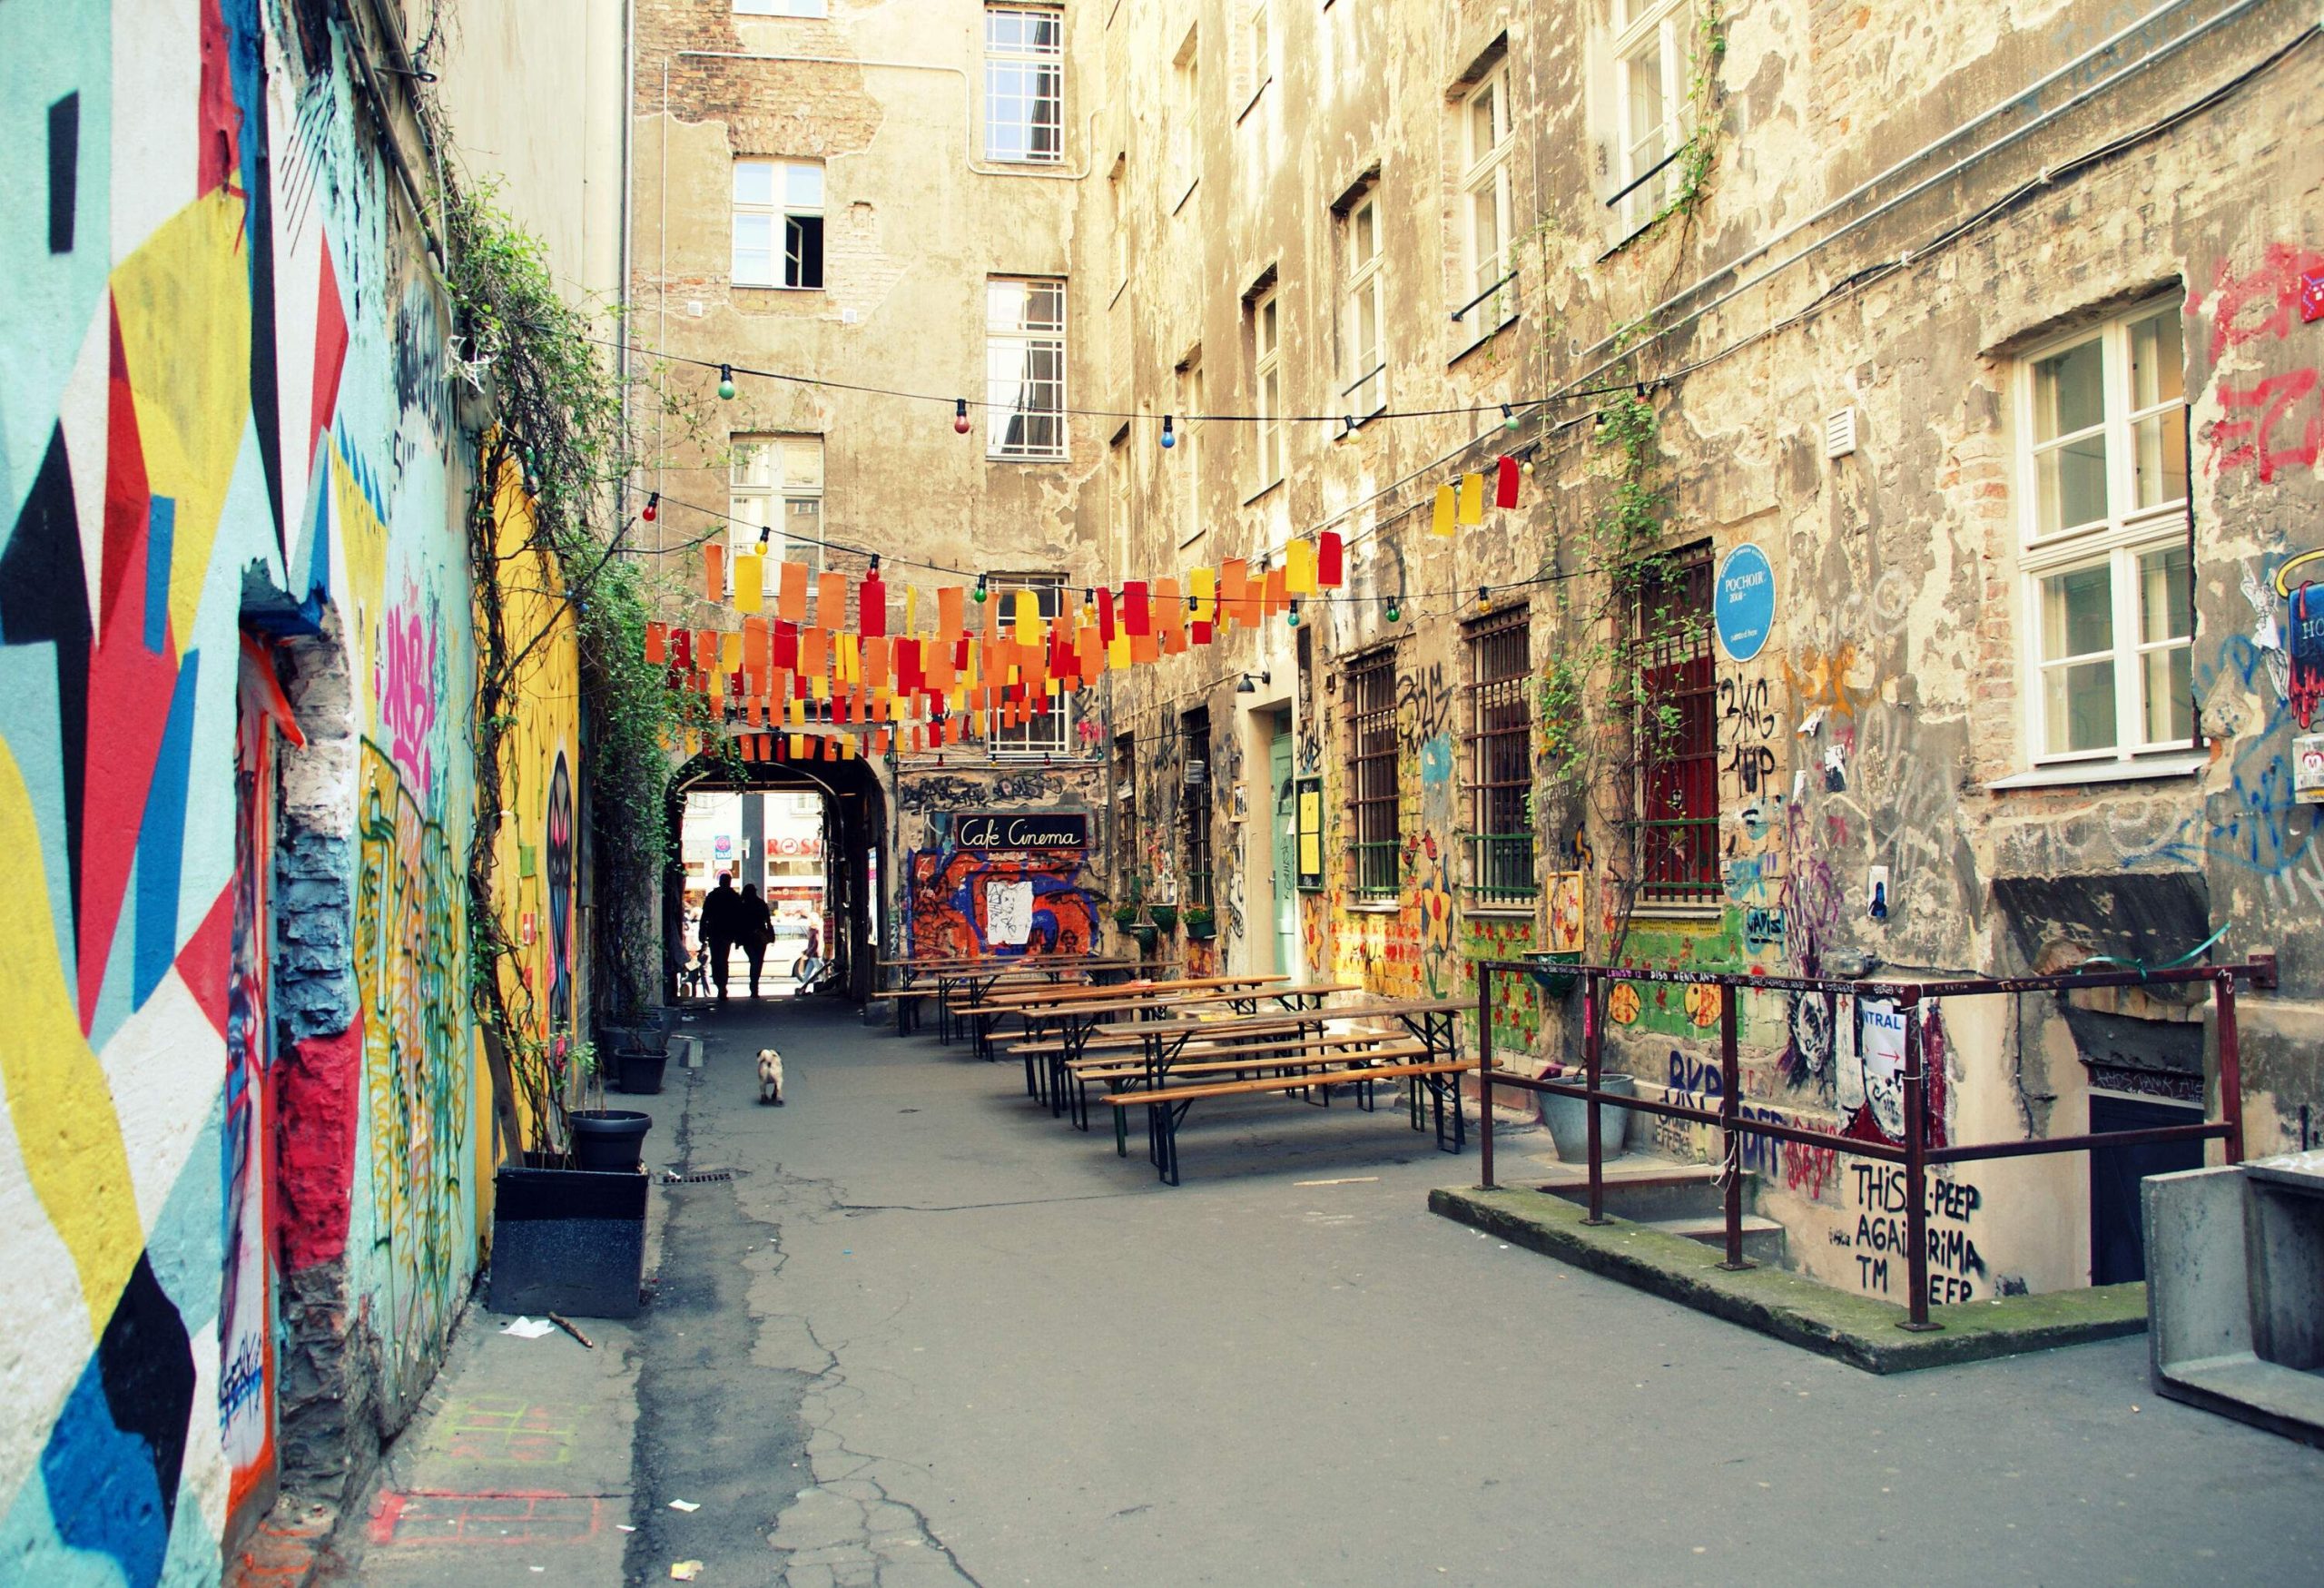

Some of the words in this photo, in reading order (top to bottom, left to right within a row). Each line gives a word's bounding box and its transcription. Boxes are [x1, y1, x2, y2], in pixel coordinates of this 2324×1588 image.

[1725, 570, 1764, 593] POCHOIR
[960, 818, 1000, 850] Café
[1008, 818, 1081, 845] Cinema
[1856, 1254, 1888, 1294] TM
